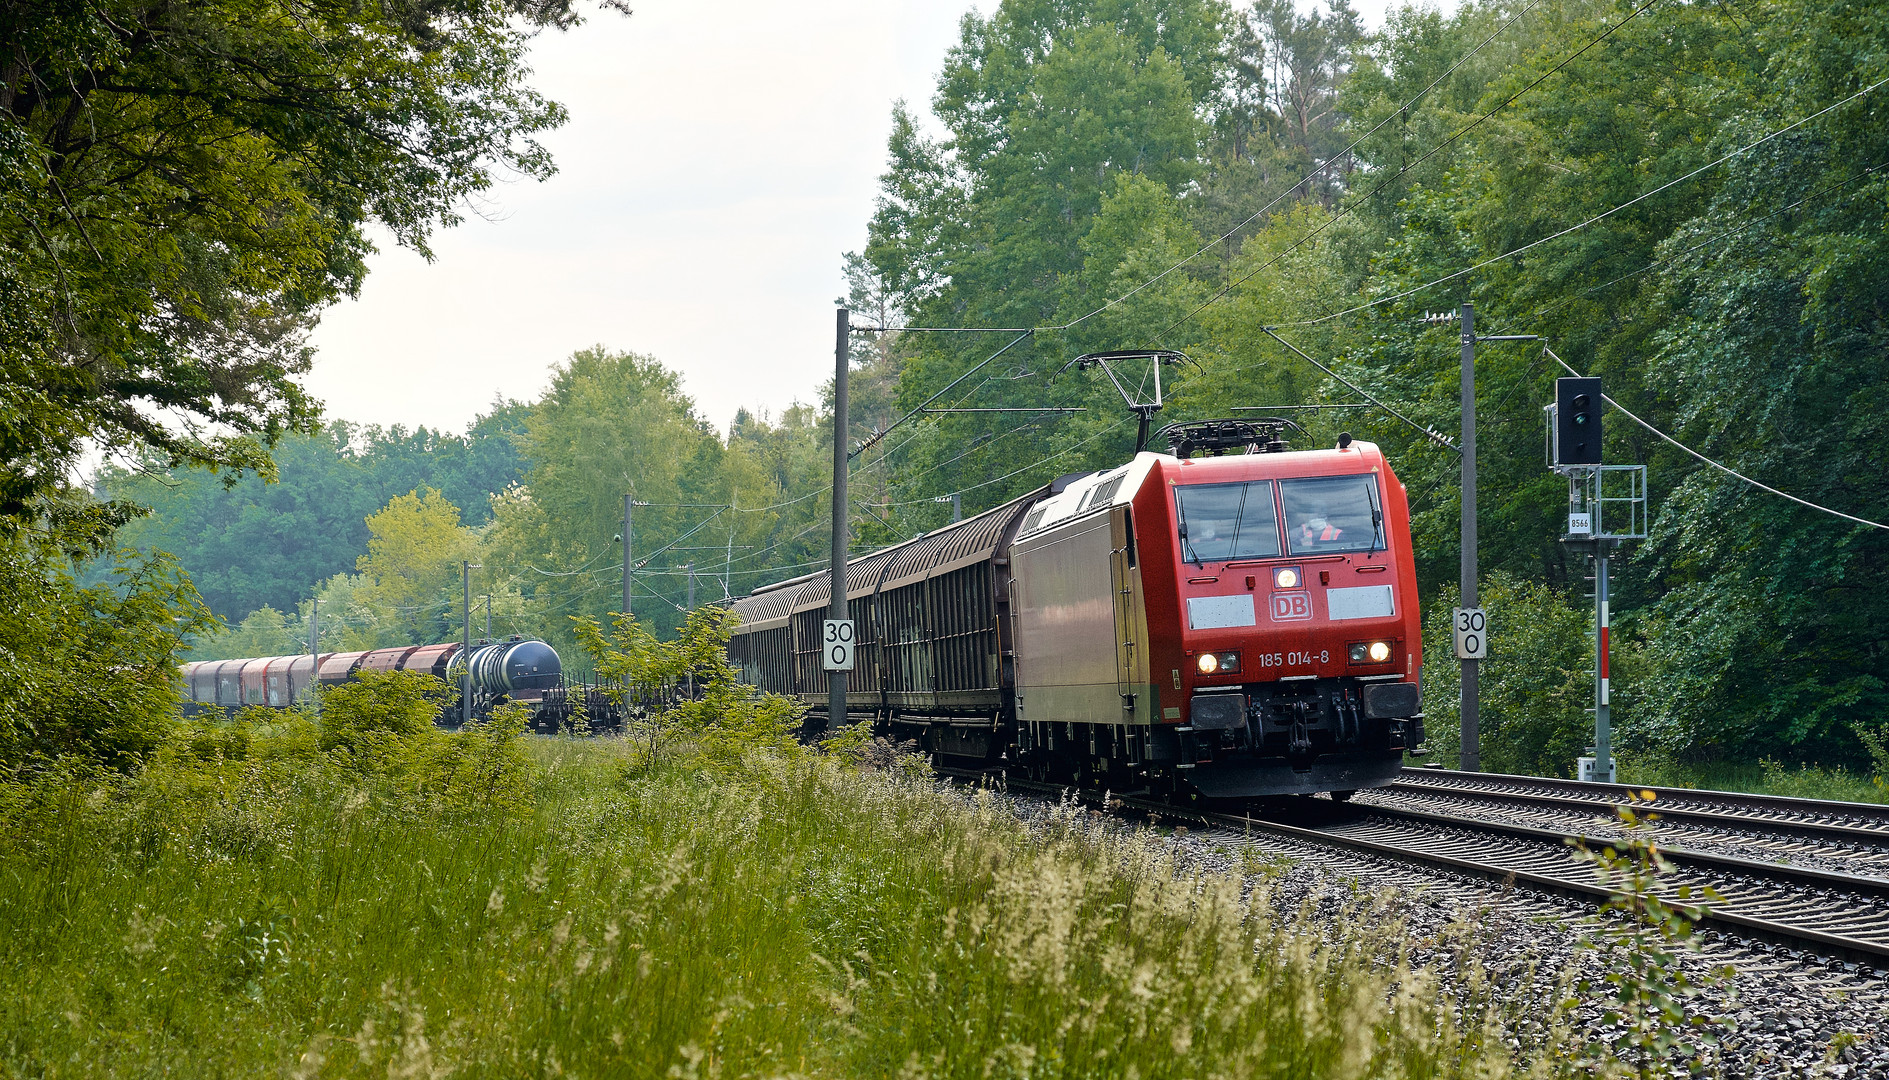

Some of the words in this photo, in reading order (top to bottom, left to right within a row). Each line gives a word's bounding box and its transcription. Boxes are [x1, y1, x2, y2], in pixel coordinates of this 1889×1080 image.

[1571, 519, 1589, 527] 8566
[1274, 595, 1308, 618] DB
[1458, 612, 1485, 632] 30
[826, 623, 852, 642] 30
[1465, 634, 1479, 654] 0
[832, 645, 846, 664] 0
[1259, 653, 1283, 667] 185
[1287, 650, 1329, 666] 014-8
